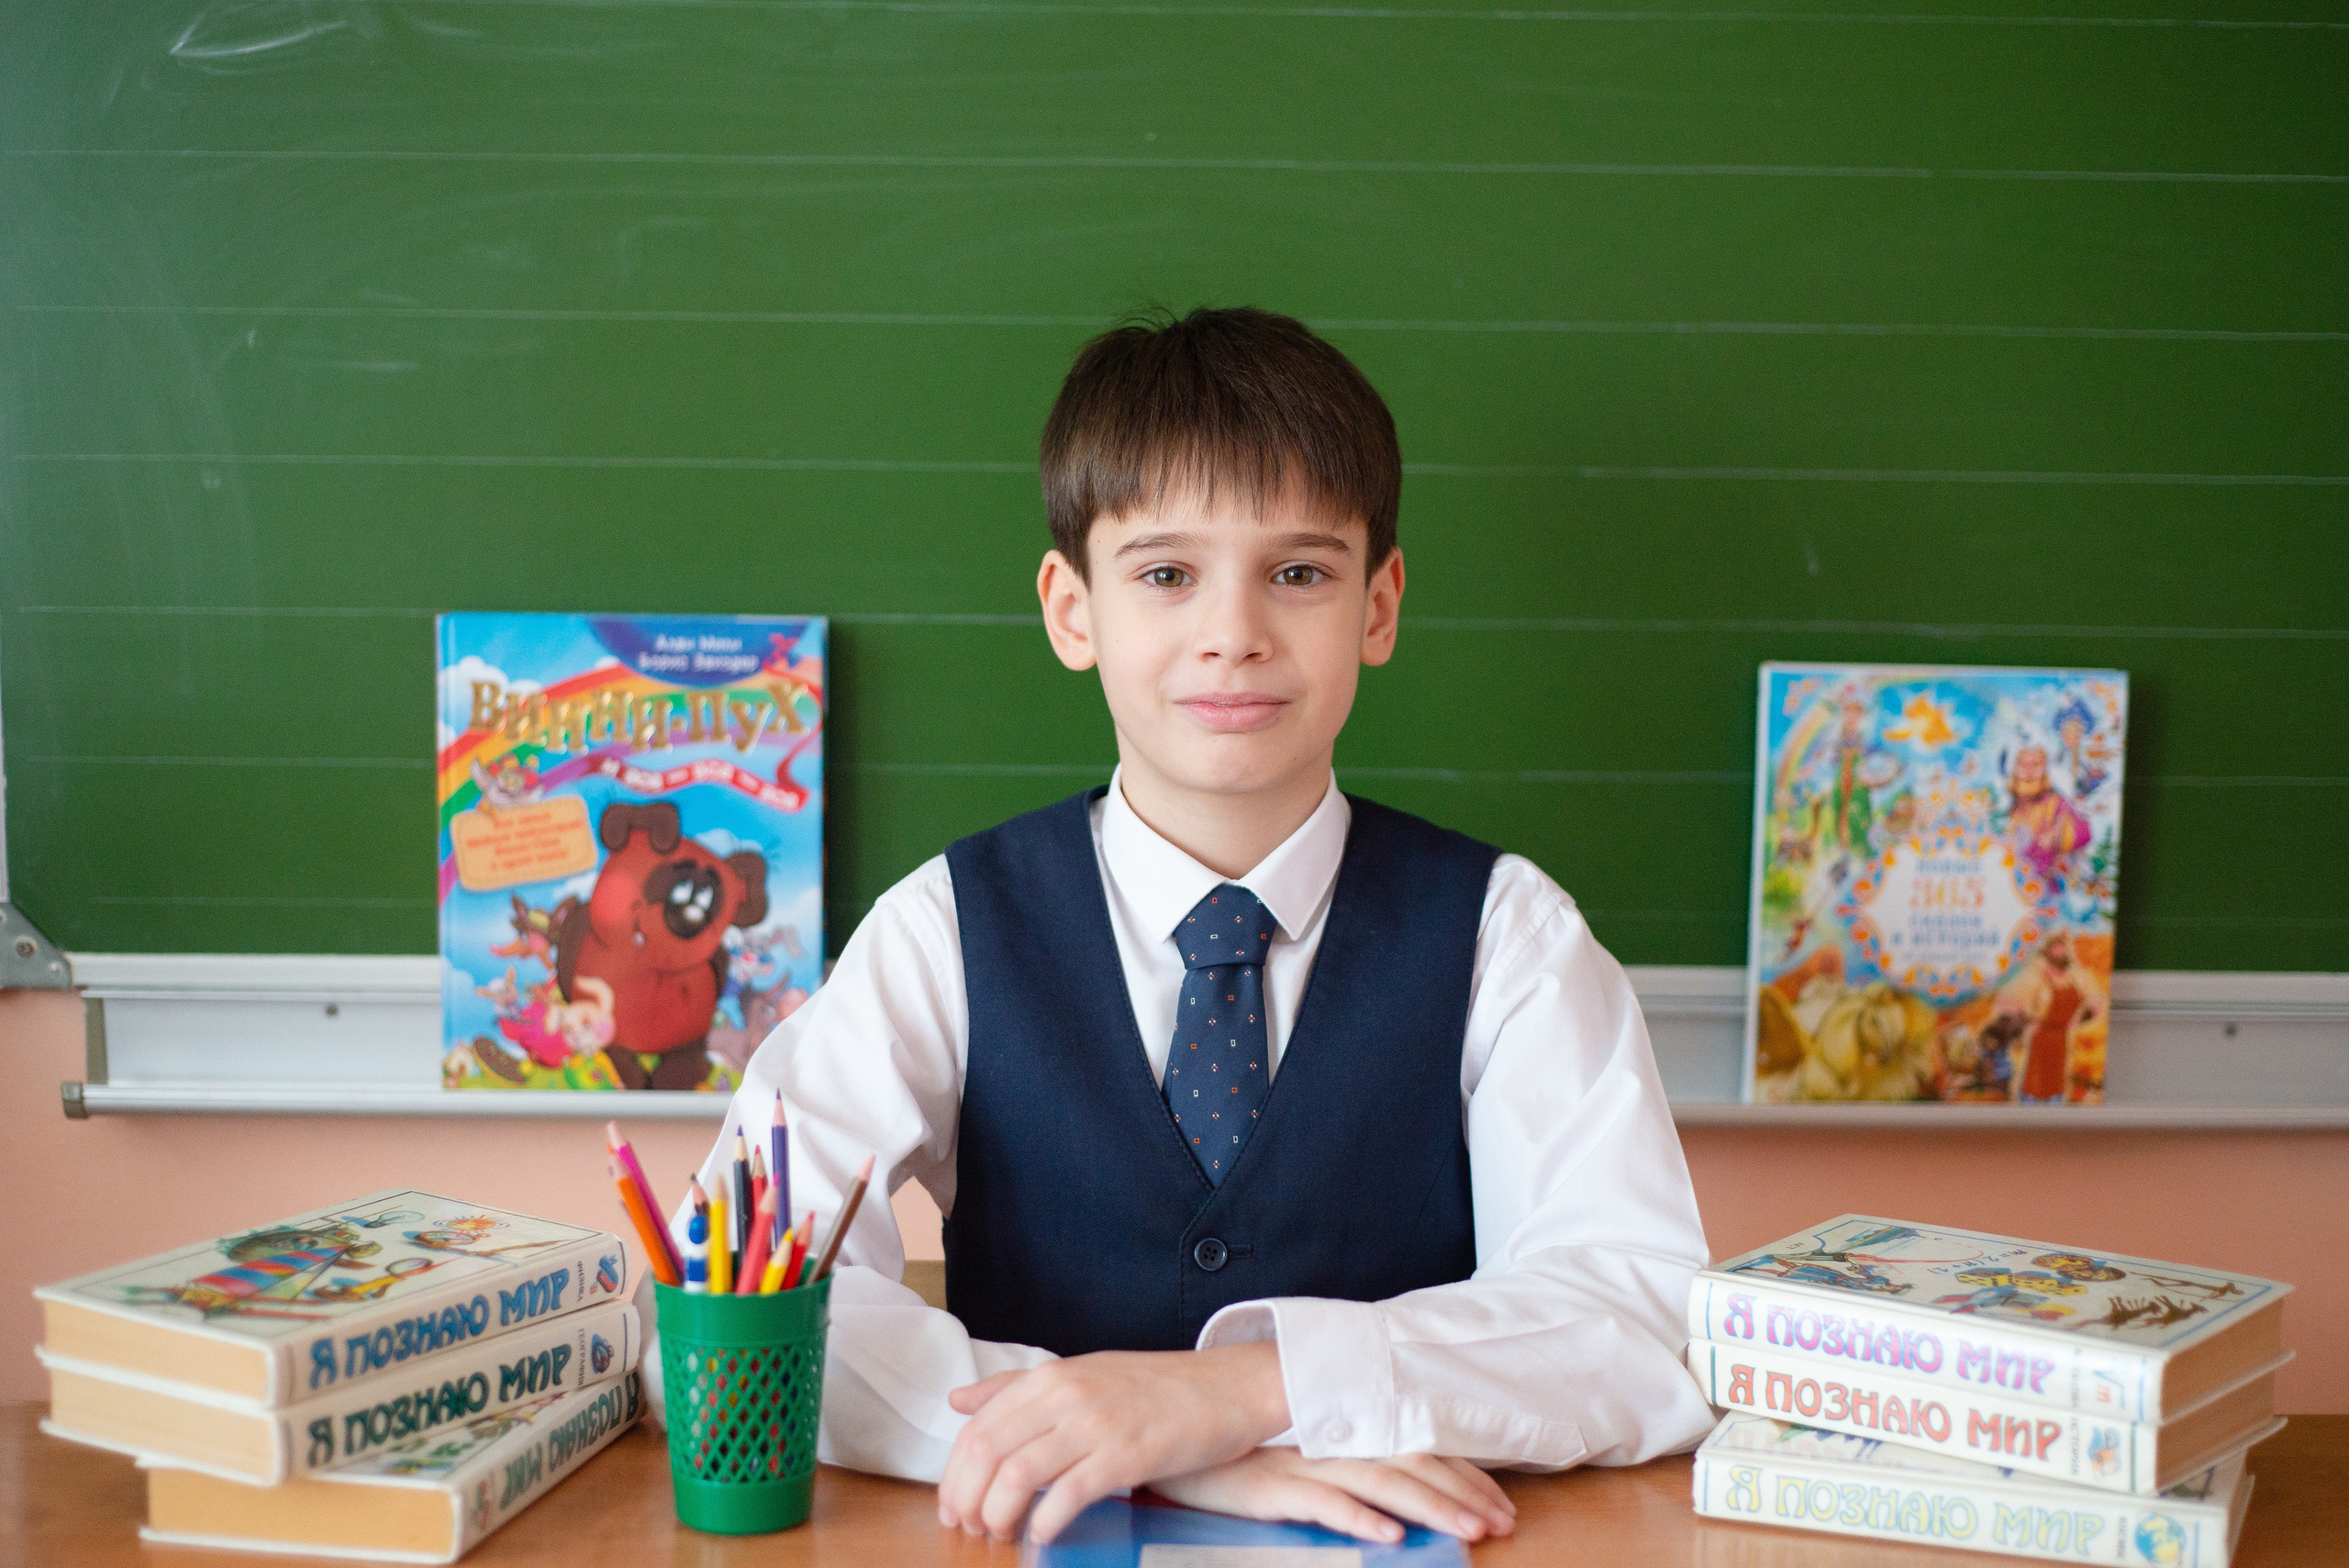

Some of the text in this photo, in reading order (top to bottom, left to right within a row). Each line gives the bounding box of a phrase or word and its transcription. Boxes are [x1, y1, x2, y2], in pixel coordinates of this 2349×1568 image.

[309, 1267, 571, 1390] Я ПОЗНАЮ МИР
[1723, 1292, 1756, 1340] Я
[1765, 1303, 1945, 1374] ПОЗНАЮ
[1957, 1338, 2056, 1396] МИР
[307, 1342, 573, 1468] Я ПОЗНАЮ МИР
[625, 1371, 640, 1423] Я
[1728, 1363, 2063, 1463] Я ПОЗНАЮ МИР
[1726, 1463, 2106, 1558] Я ПОЗНАЮ МИР
